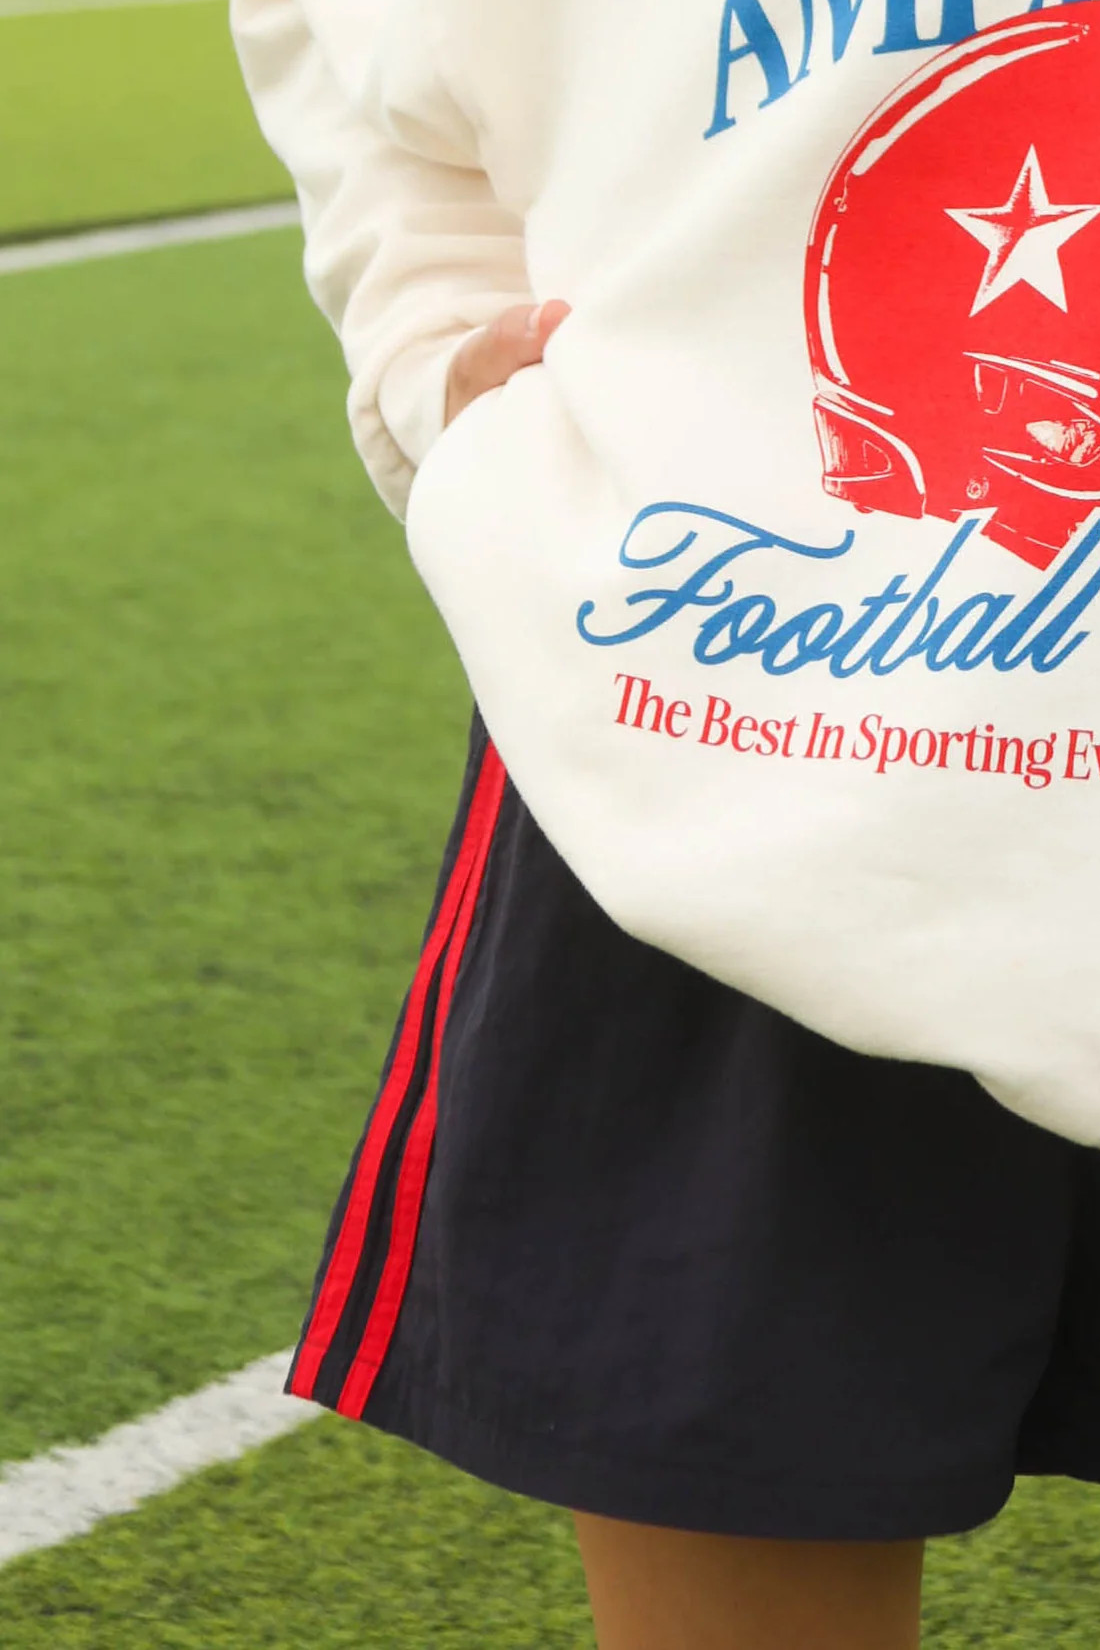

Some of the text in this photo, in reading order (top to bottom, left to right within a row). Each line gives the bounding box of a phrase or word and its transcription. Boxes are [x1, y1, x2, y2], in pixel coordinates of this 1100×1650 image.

[613, 673, 692, 740] The
[696, 695, 800, 760] Best
[801, 711, 846, 761] In
[850, 714, 1058, 790] Sporting
